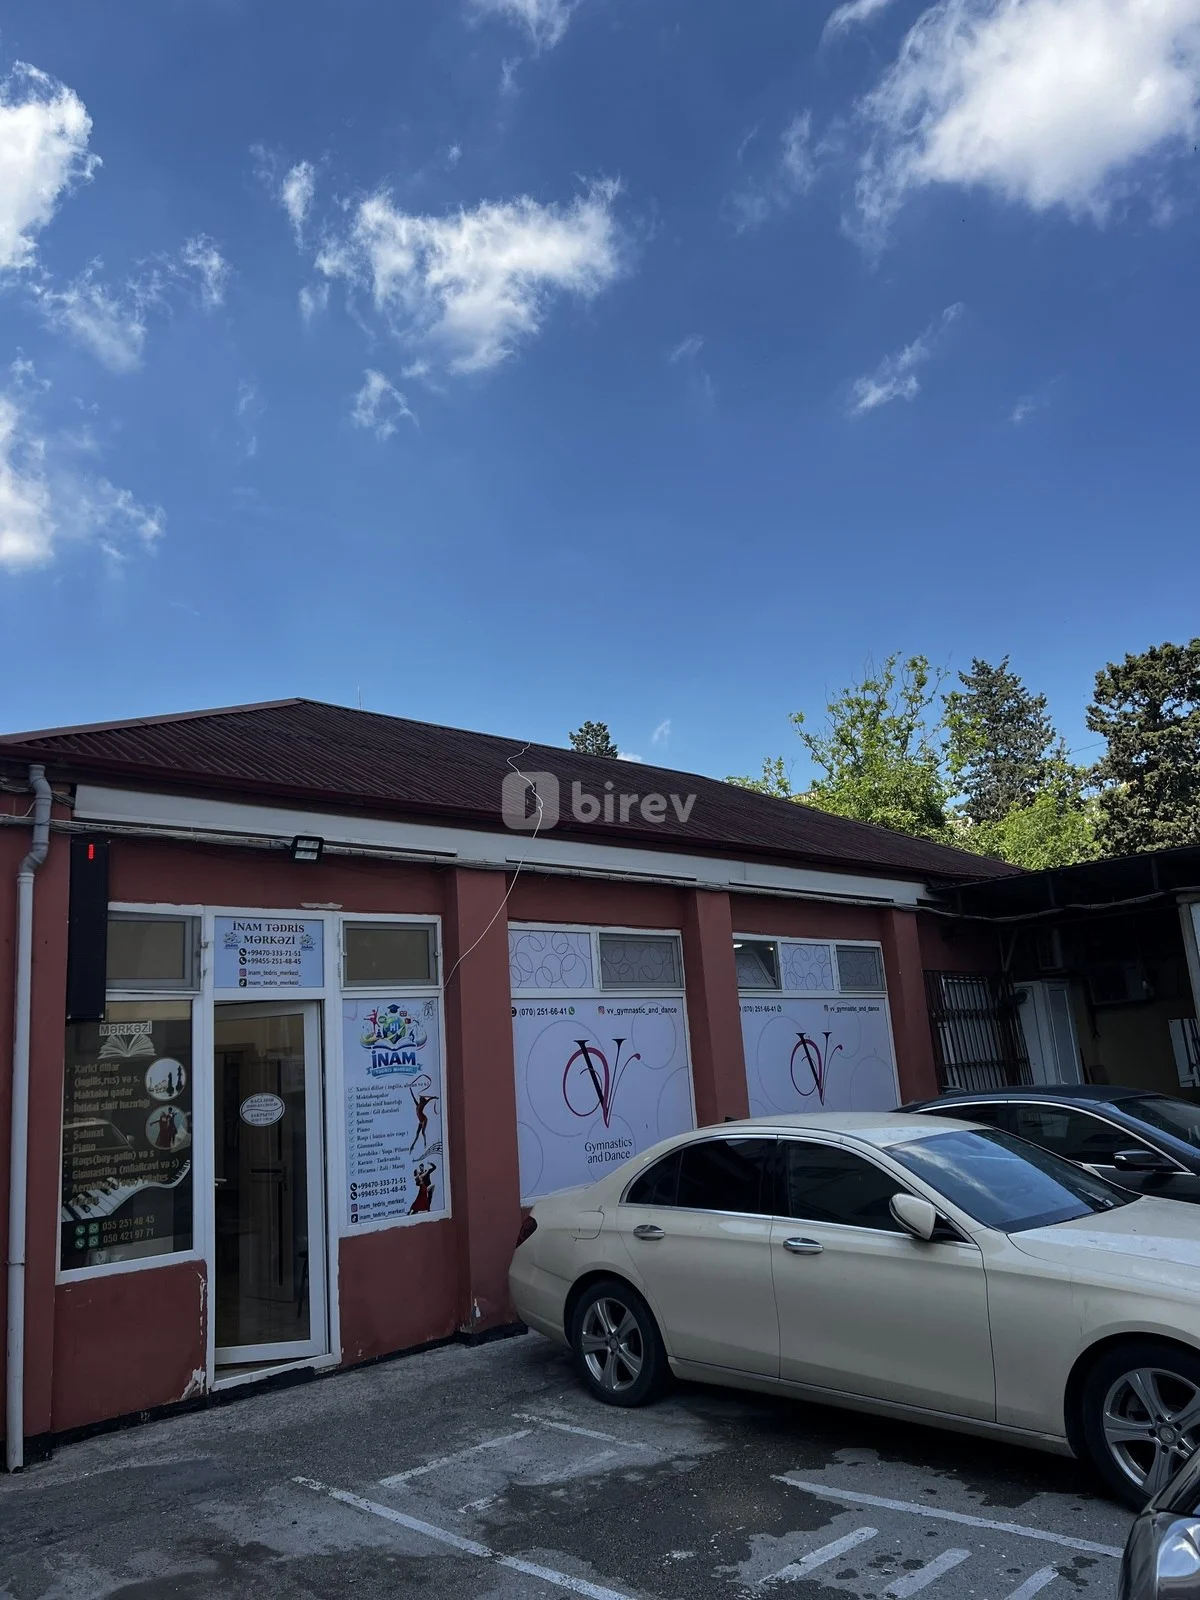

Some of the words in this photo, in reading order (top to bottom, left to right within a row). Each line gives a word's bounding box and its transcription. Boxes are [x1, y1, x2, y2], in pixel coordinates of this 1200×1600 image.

[233, 921, 262, 931] İNAM
[265, 923, 305, 933] TƏDRİS
[243, 935, 295, 945] MƏRKƏZİ
[519, 1007, 536, 1016] (070)
[537, 1007, 567, 1016] 251-66-41
[606, 1006, 677, 1016] vv_gymnastic_and_dance
[100, 1021, 152, 1035] MƏRKƏZİ
[584, 1136, 633, 1154] Gymnastics
[588, 1152, 604, 1164] and
[604, 1150, 631, 1162] Dance
[358, 1176, 406, 1190] +99470-333-71-51
[358, 1185, 407, 1198] +99455-251-48-45
[102, 1222, 116, 1230] 055
[120, 1219, 132, 1228] 251
[146, 1215, 154, 1224] 45
[104, 1234, 118, 1244] 050
[120, 1232, 133, 1241] 421
[134, 1229, 144, 1238] 97
[146, 1228, 154, 1236] 71
